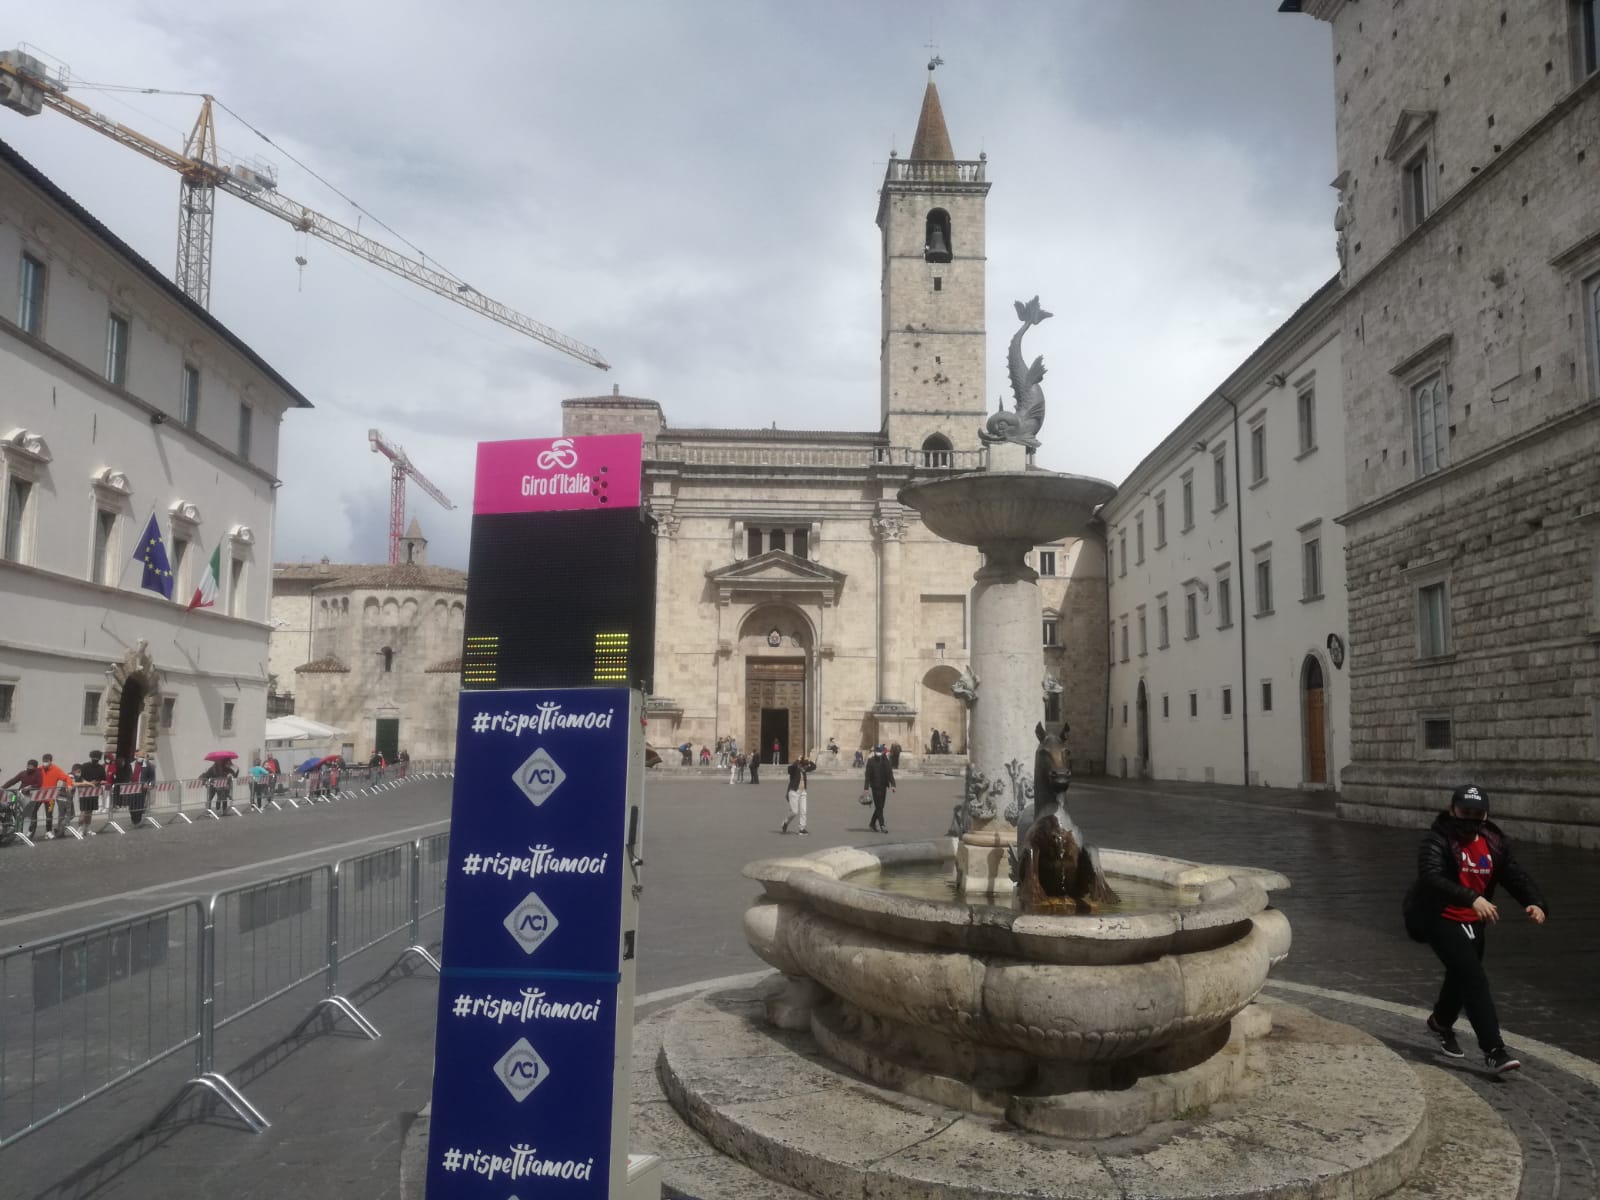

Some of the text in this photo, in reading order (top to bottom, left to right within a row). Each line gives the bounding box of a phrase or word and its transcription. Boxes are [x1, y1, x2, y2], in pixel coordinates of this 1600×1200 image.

[522, 475, 547, 496] Giro
[471, 701, 614, 737] #rispettiamoci
[528, 769, 555, 784] ACI
[462, 844, 608, 880] #rispettiamoci
[519, 915, 548, 931] ACI
[452, 987, 601, 1024] #rispettiamoci
[510, 1061, 538, 1079] ACI
[442, 1144, 594, 1181] #rispettiamoci
